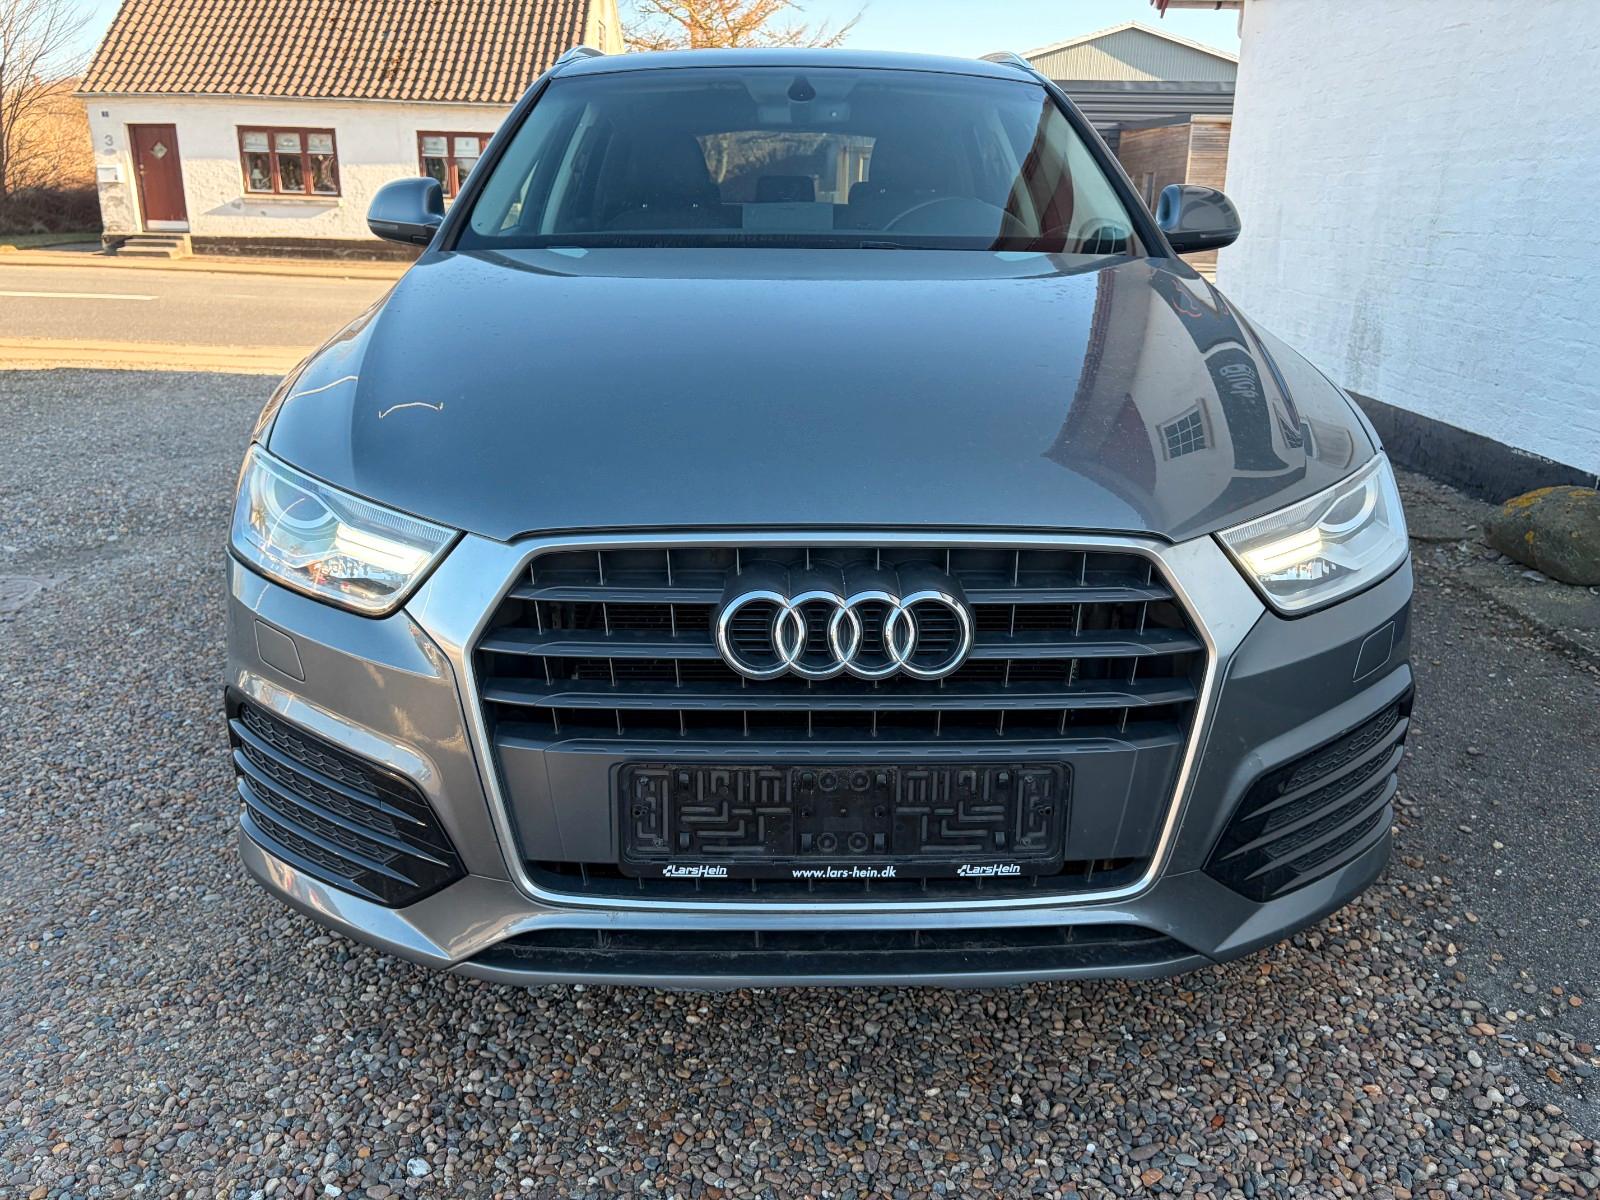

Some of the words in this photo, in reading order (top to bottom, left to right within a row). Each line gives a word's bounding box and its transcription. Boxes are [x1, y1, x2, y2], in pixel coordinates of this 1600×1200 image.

[104, 134, 114, 146] 3
[669, 864, 728, 878] LarsHein
[792, 865, 897, 879] www.lars-hein.dk
[965, 863, 1021, 877] LarsHein
